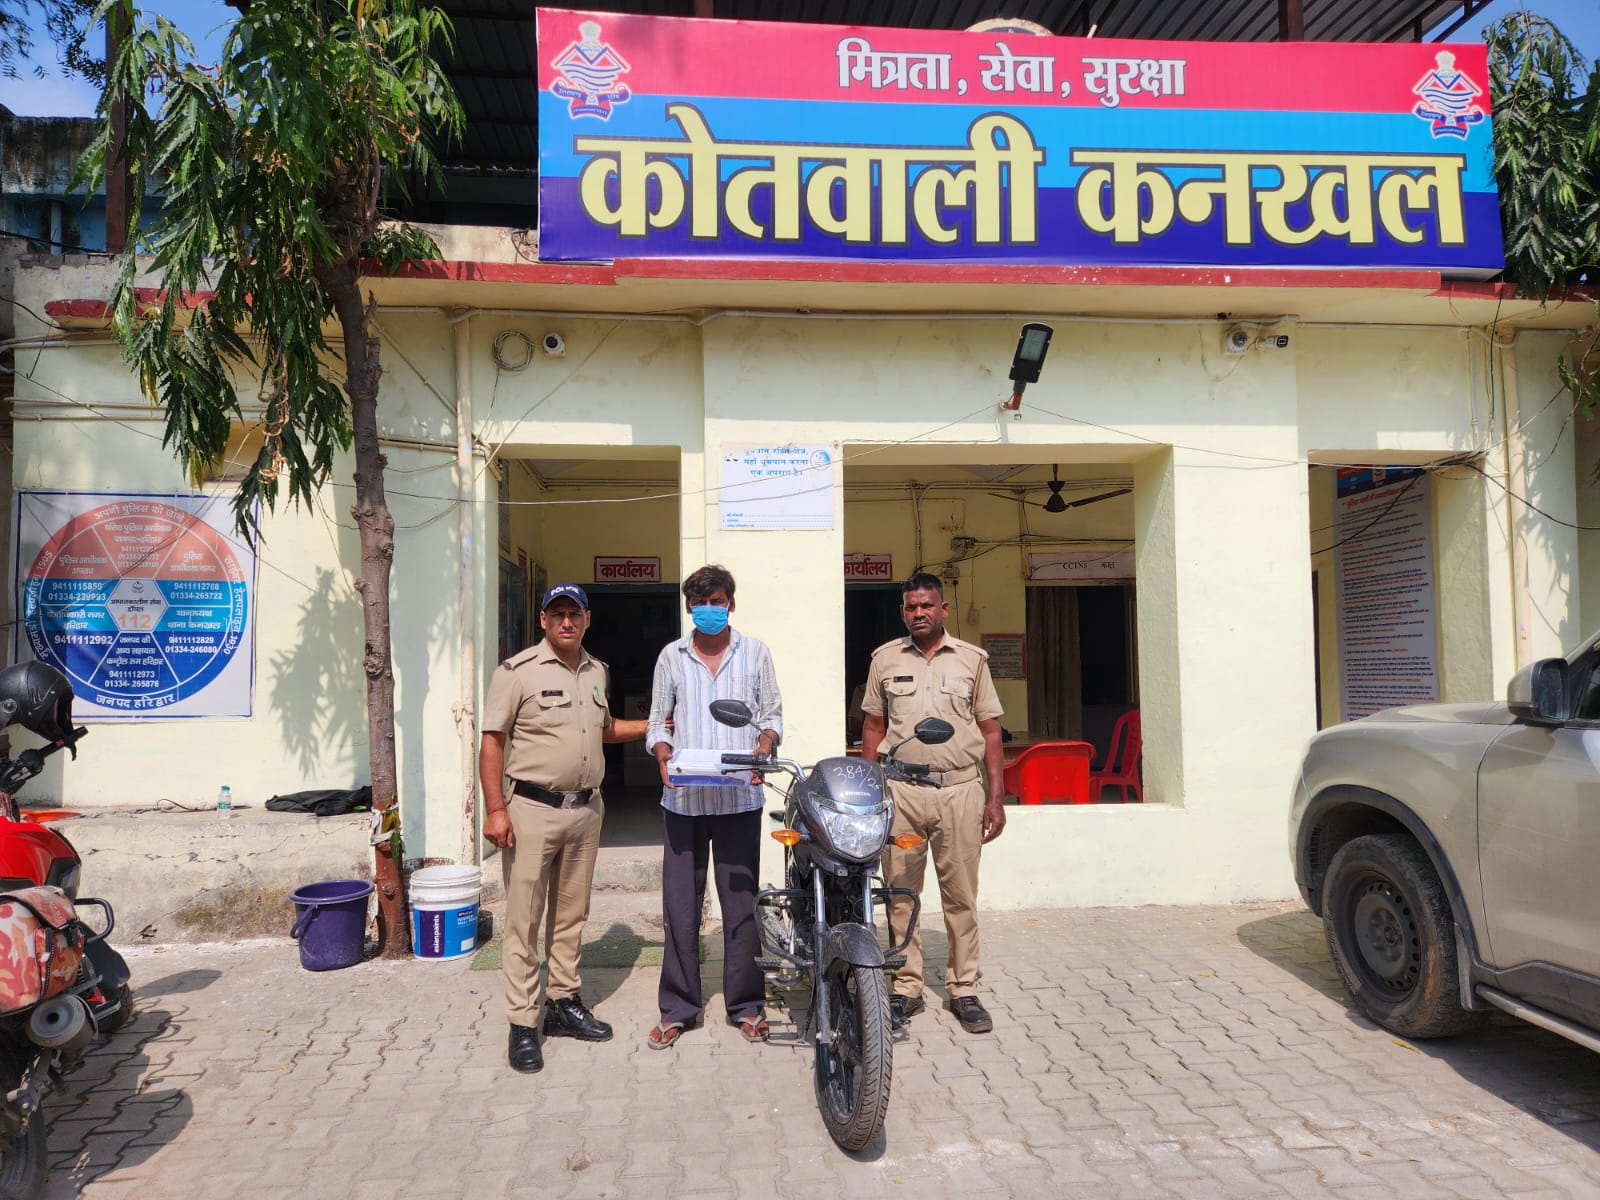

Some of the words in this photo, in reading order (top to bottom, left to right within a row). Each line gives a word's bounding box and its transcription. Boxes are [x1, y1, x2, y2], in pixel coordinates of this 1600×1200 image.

[1082, 56, 1186, 108] सुरक्षा
[574, 103, 1045, 246] कोतवाली
[1071, 146, 1467, 247] कनखल
[122, 502, 148, 516] पुलिस
[600, 560, 656, 578] कार्यालय
[118, 613, 152, 629] 112
[96, 694, 131, 708] जनपद
[134, 693, 175, 708] हरिद्वार
